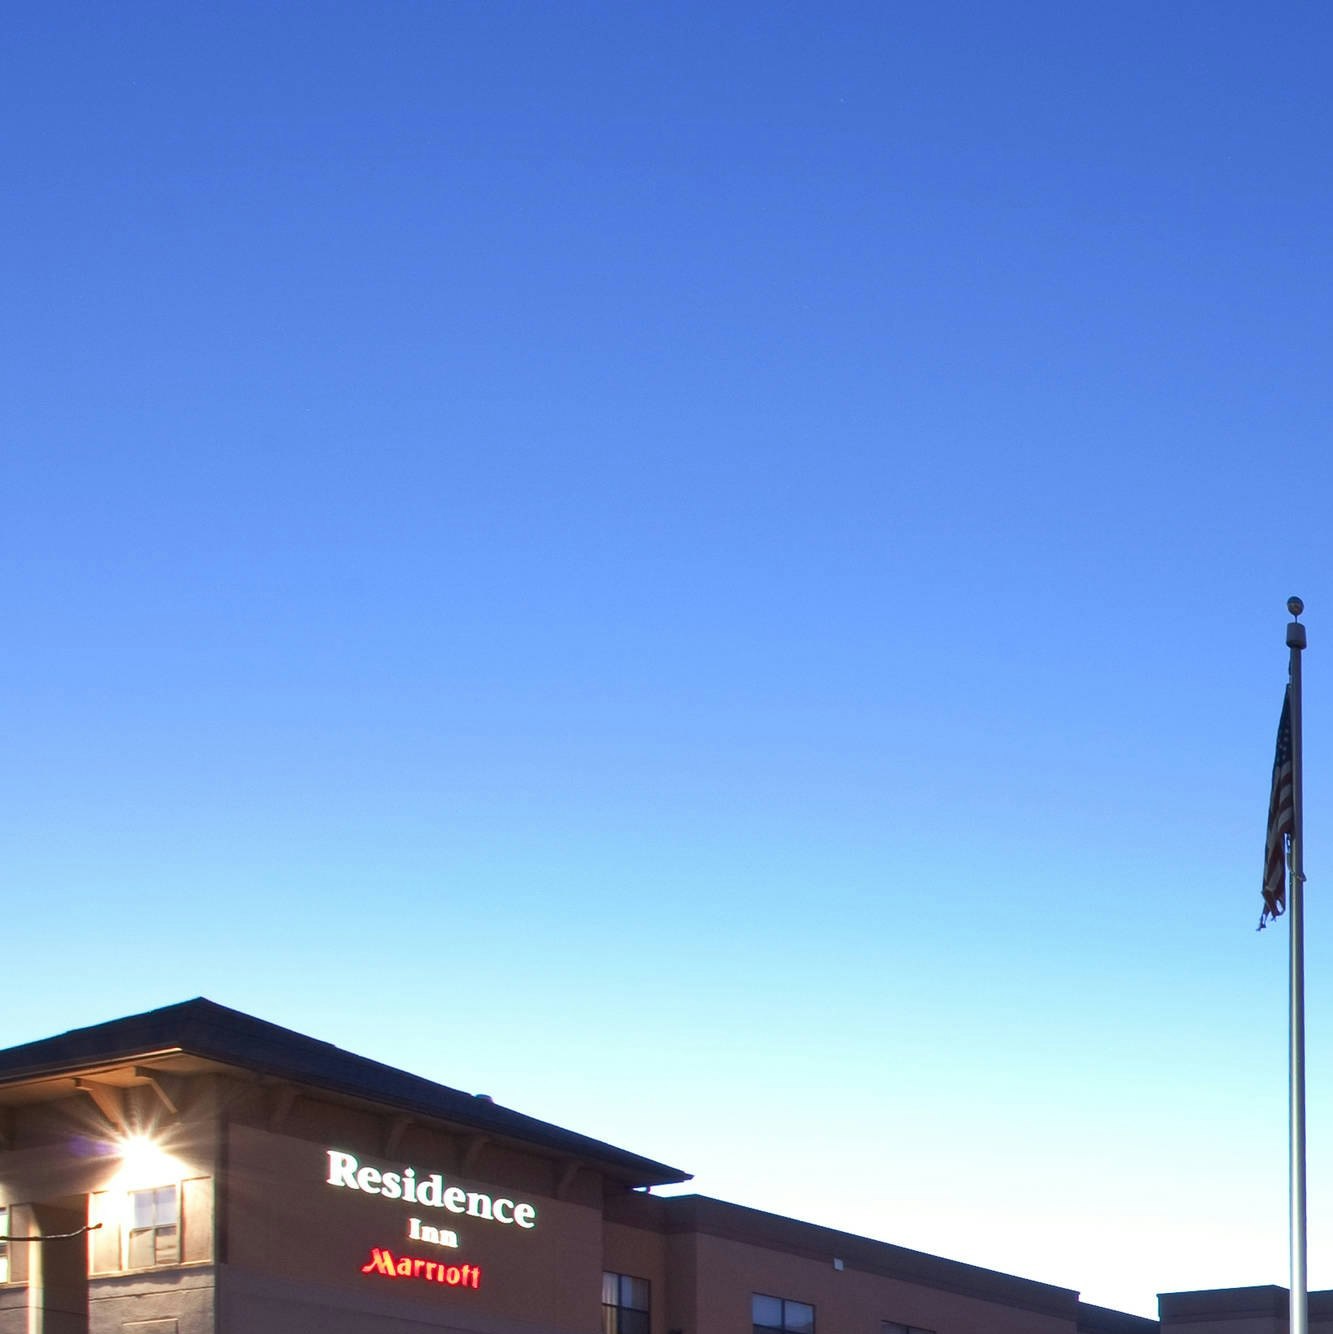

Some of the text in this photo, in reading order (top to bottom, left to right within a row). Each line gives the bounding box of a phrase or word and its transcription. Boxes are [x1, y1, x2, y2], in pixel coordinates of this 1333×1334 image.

[326, 1150, 536, 1229] Residence
[408, 1218, 458, 1248] Inn
[361, 1248, 481, 1289] Marriott
